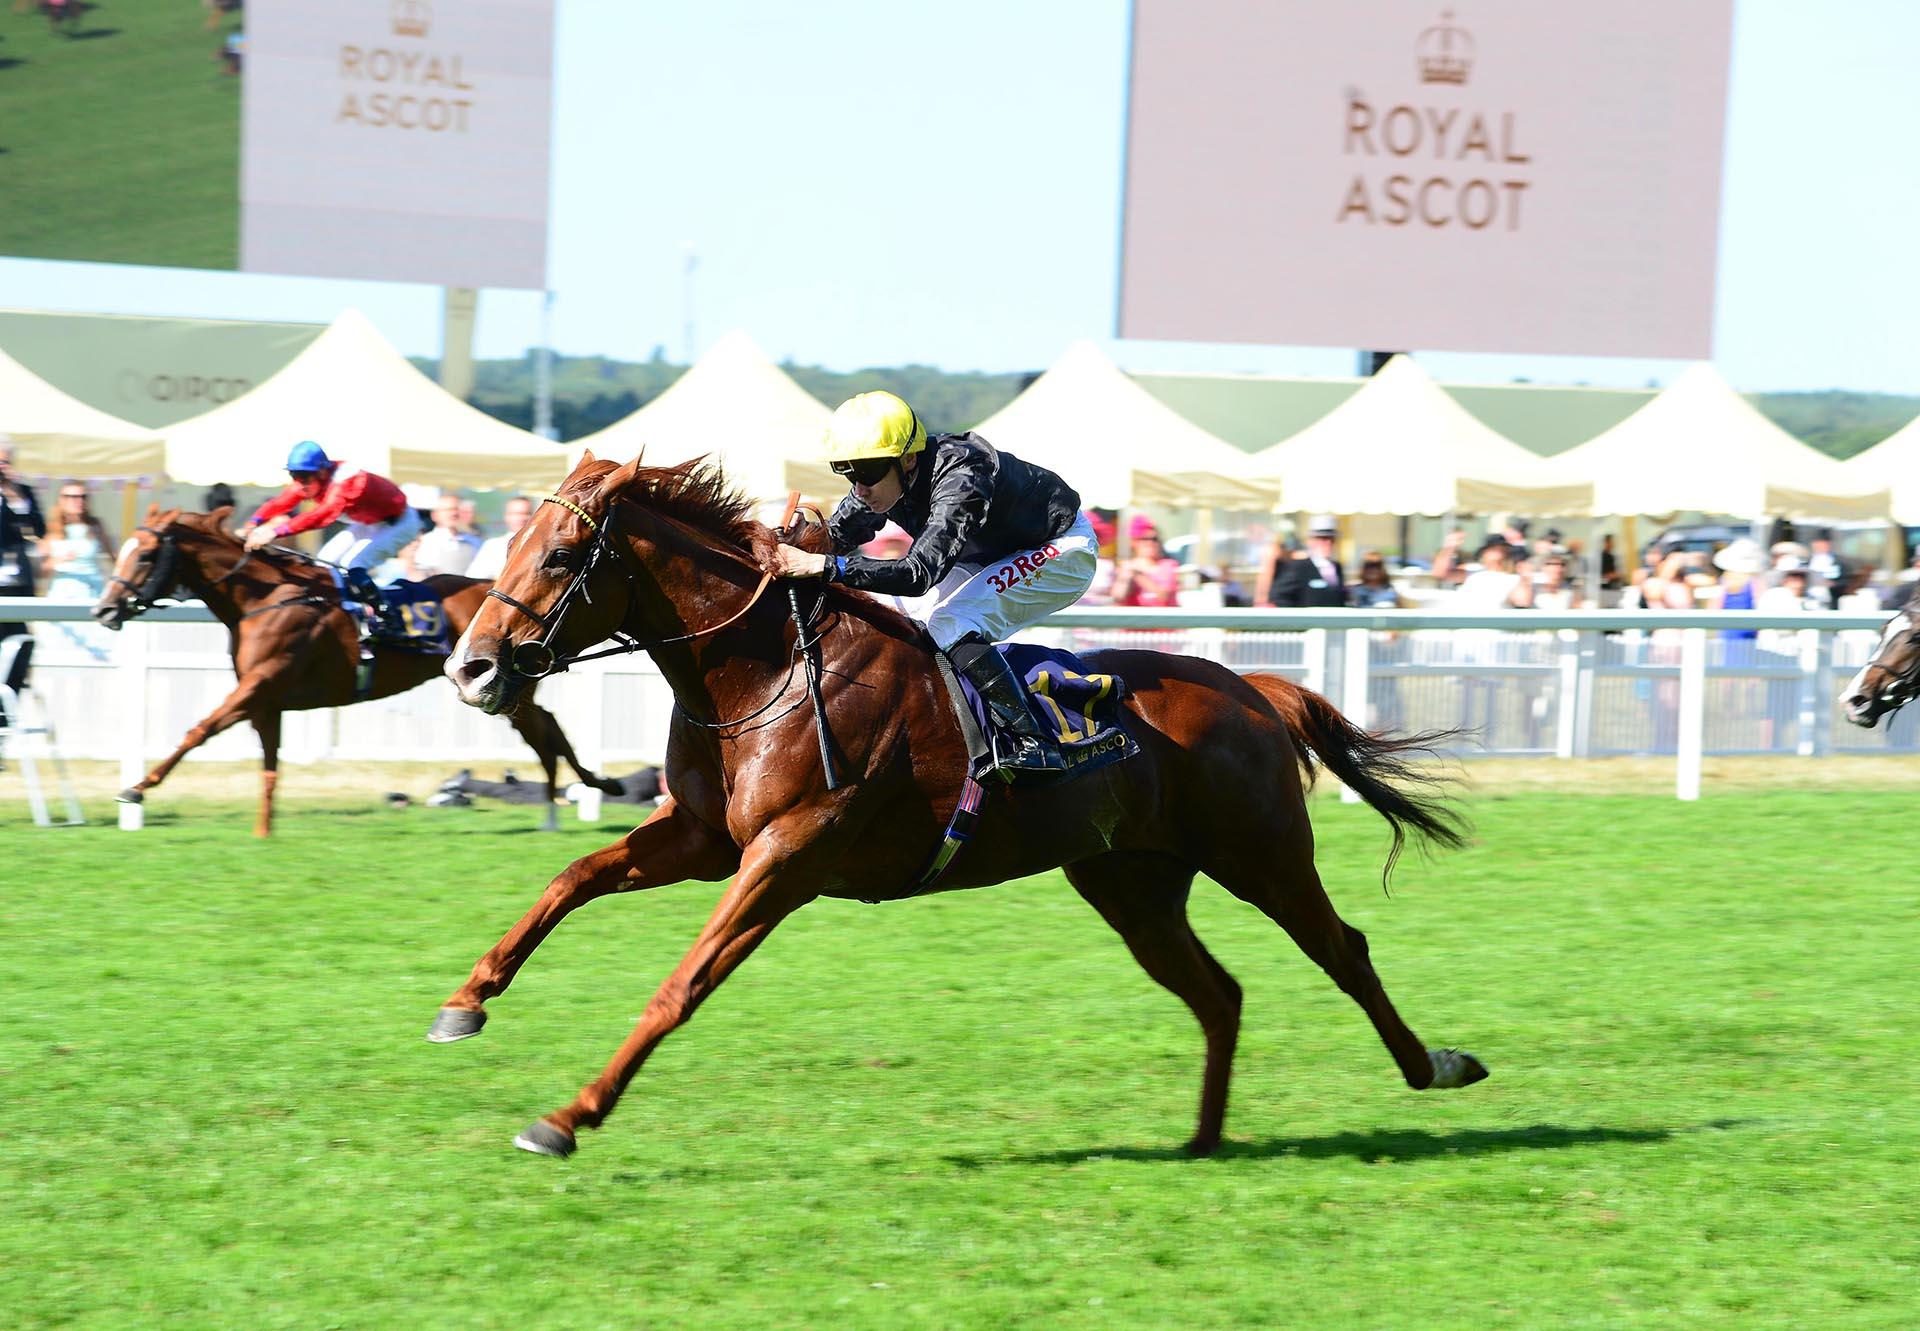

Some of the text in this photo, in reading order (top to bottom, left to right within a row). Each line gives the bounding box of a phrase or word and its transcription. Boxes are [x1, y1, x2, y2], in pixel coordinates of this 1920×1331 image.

[338, 44, 473, 90] ROYAL
[334, 93, 473, 132] ASCOT
[1342, 99, 1531, 163] ROYAL
[1334, 173, 1531, 232] ASCOT
[400, 601, 440, 636] 19
[1027, 670, 1112, 744] 17
[1091, 734, 1127, 758] ASCO
